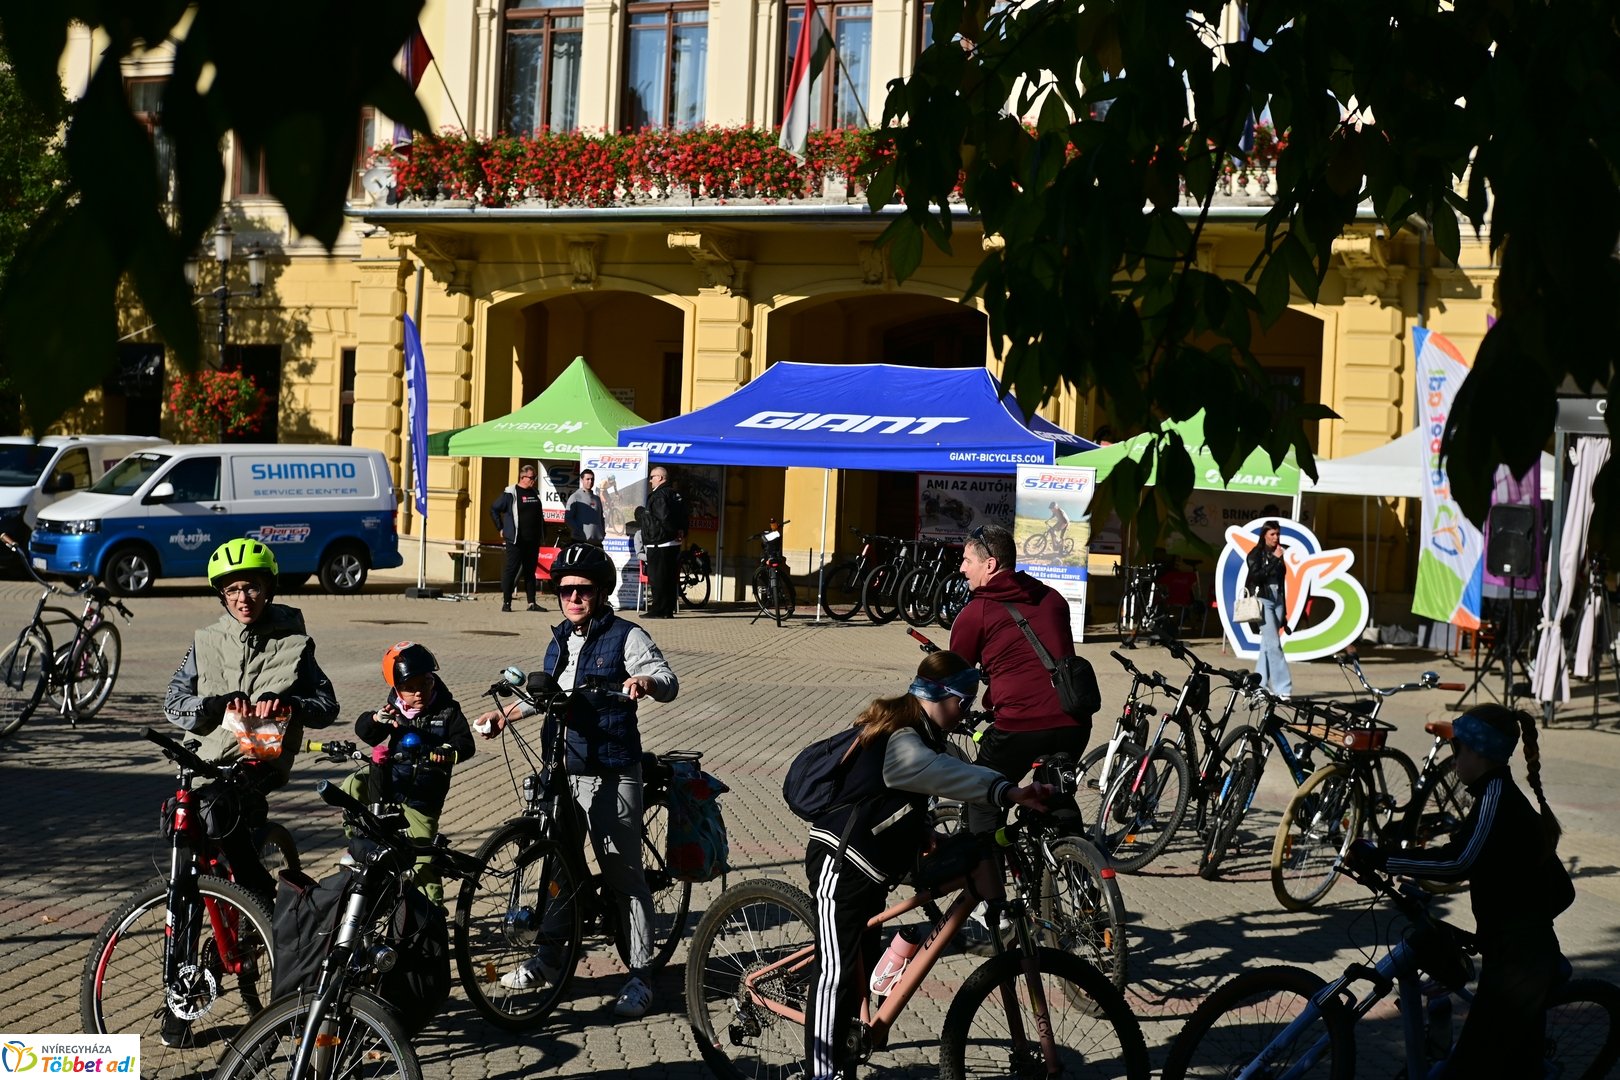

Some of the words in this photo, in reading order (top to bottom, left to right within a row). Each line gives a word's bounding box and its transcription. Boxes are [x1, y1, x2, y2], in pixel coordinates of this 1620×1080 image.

[494, 422, 558, 431] HYBRID
[734, 410, 970, 435] GIANT
[949, 452, 1045, 464] GIANT-BICYCLES.COM
[588, 460, 639, 469] SZIGET
[251, 463, 356, 480] SHIMANO
[926, 479, 949, 490] AMI
[951, 480, 968, 491] AZ
[969, 479, 1016, 492] AUTÓH
[1024, 478, 1085, 490] SZIGET
[254, 488, 303, 496] SERVICE
[306, 488, 358, 496] CENTER
[924, 908, 954, 951] CUBE
